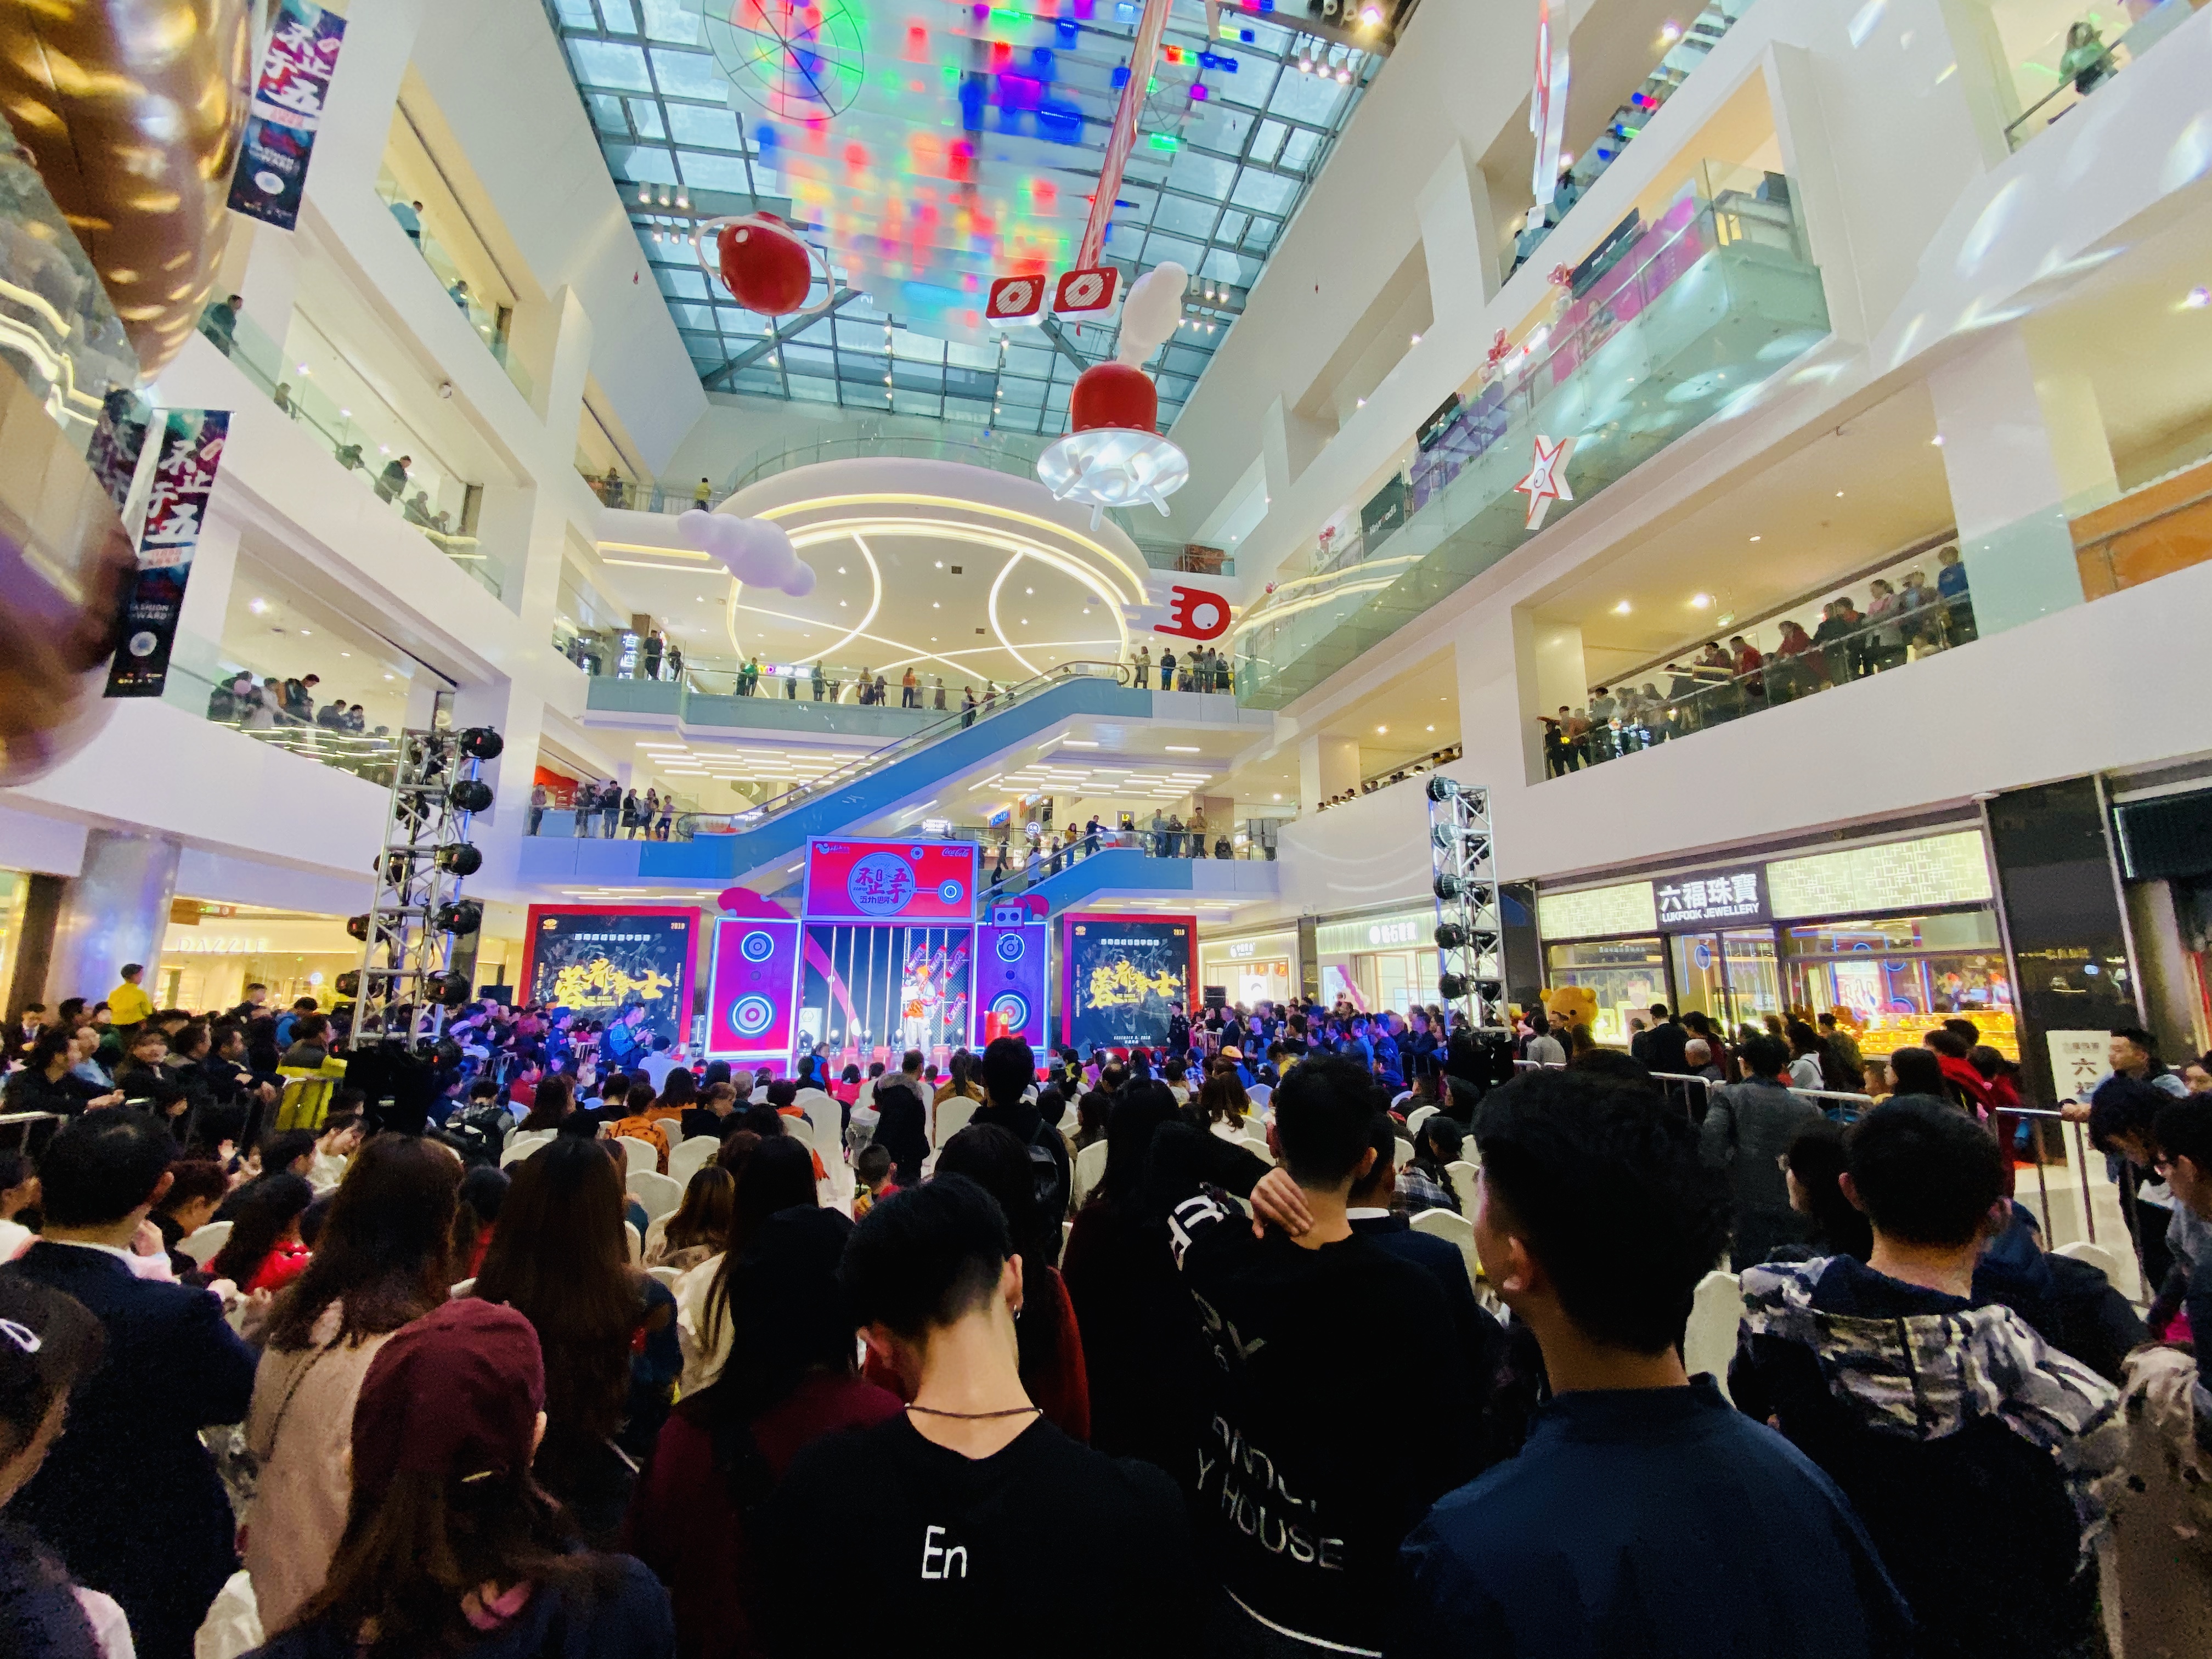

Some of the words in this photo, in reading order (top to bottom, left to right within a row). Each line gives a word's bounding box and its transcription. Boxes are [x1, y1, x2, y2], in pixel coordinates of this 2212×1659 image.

[1659, 873, 1758, 912] 六福珠寶
[1662, 909, 1703, 923] LUKFOOK
[1703, 902, 1760, 918] JEWELLERY
[178, 938, 265, 953] DAZZLE
[1221, 1471, 1344, 1571] HOUSE
[921, 1525, 967, 1579] En
